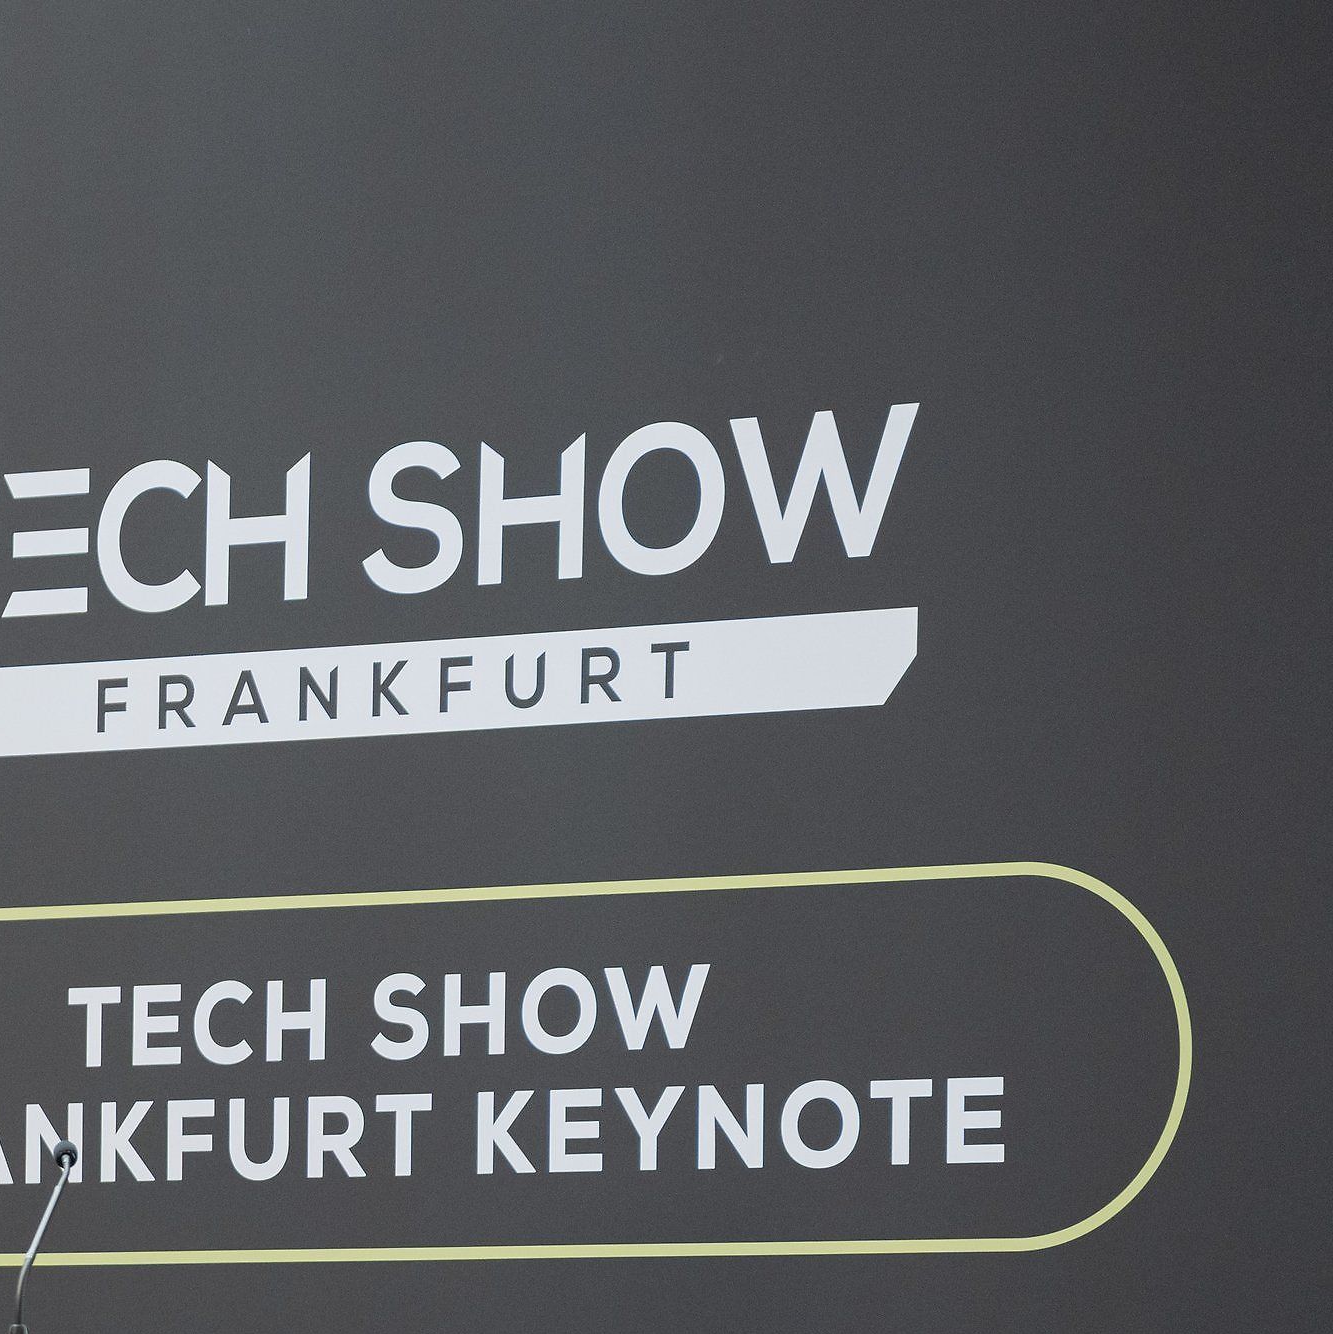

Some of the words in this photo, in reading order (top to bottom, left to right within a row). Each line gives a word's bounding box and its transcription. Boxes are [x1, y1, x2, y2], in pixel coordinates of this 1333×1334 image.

[362, 402, 920, 595] SHOW
[95, 641, 692, 734] FRANKFURT
[67, 978, 327, 1068] TECH
[371, 963, 711, 1061] SHOW
[476, 1076, 1005, 1175] KEYNOTE
